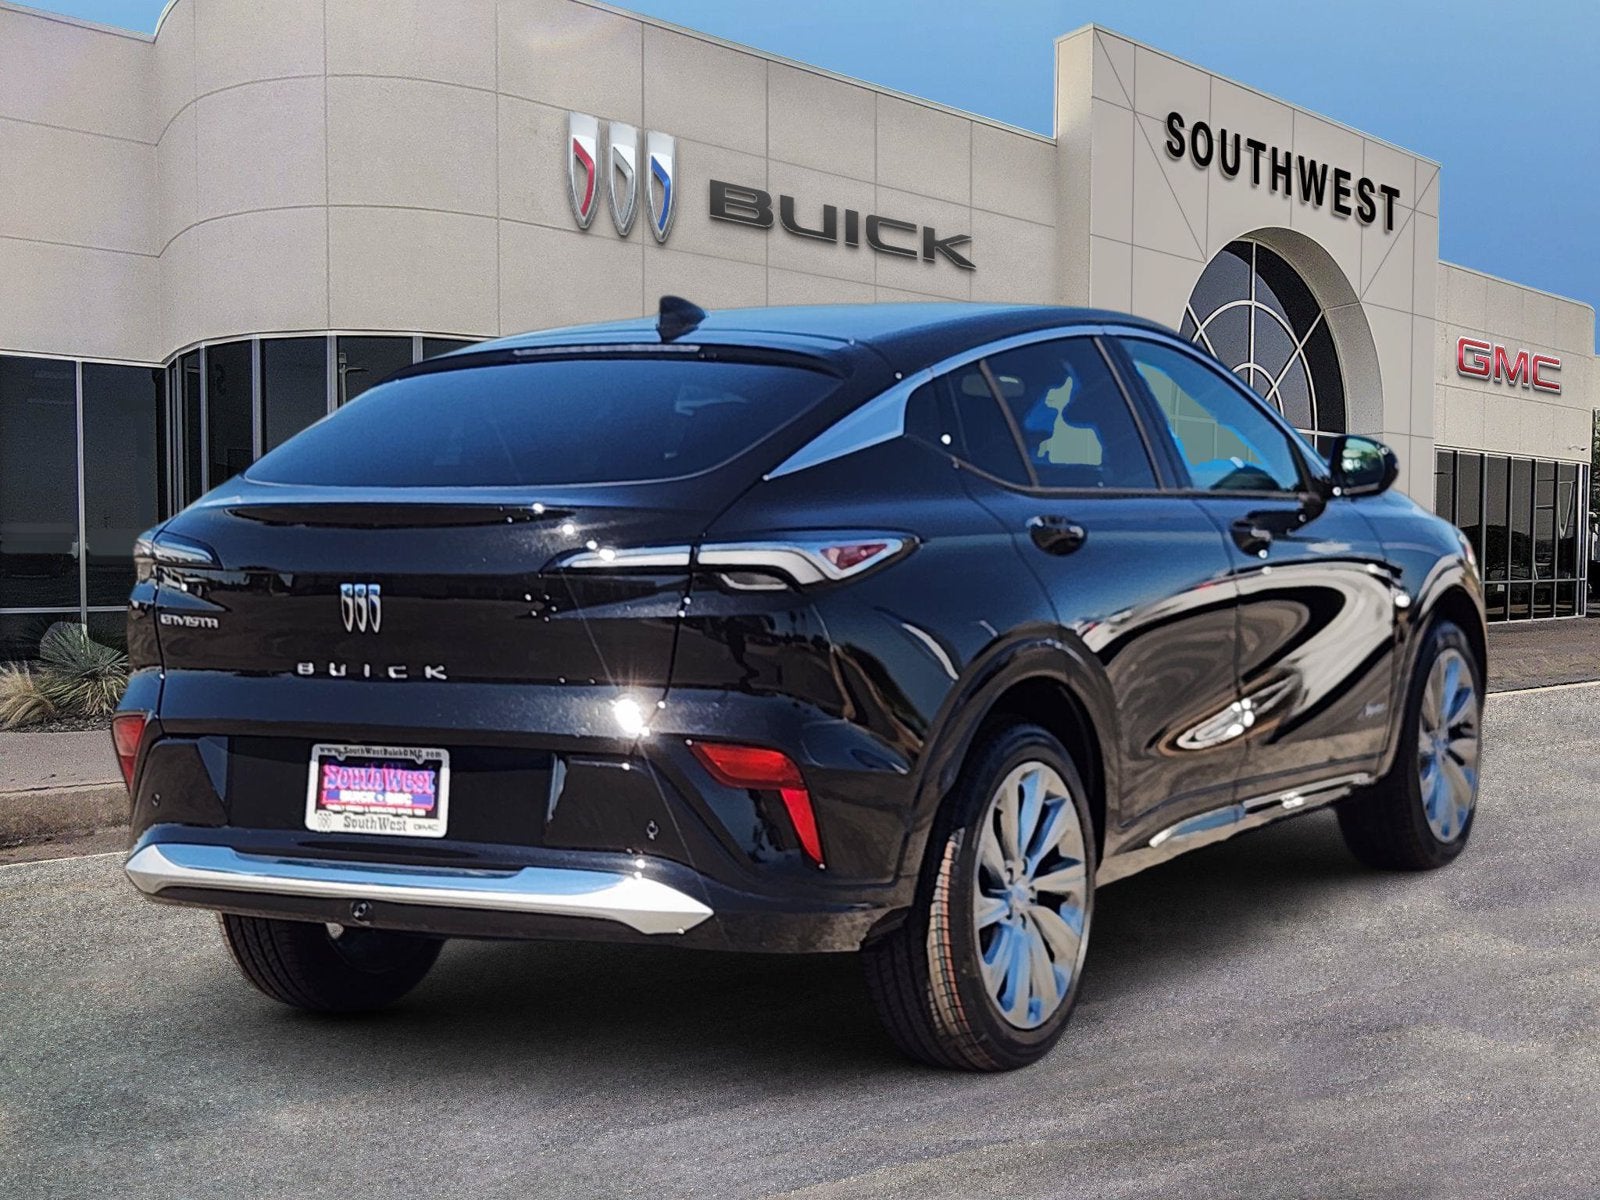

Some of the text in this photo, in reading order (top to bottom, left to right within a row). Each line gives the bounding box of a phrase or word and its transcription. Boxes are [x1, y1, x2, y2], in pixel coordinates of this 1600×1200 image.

[1166, 111, 1400, 232] SOUTHWEST
[709, 179, 976, 270] BUICK
[1456, 336, 1562, 394] GMC
[297, 662, 448, 680] BUICK
